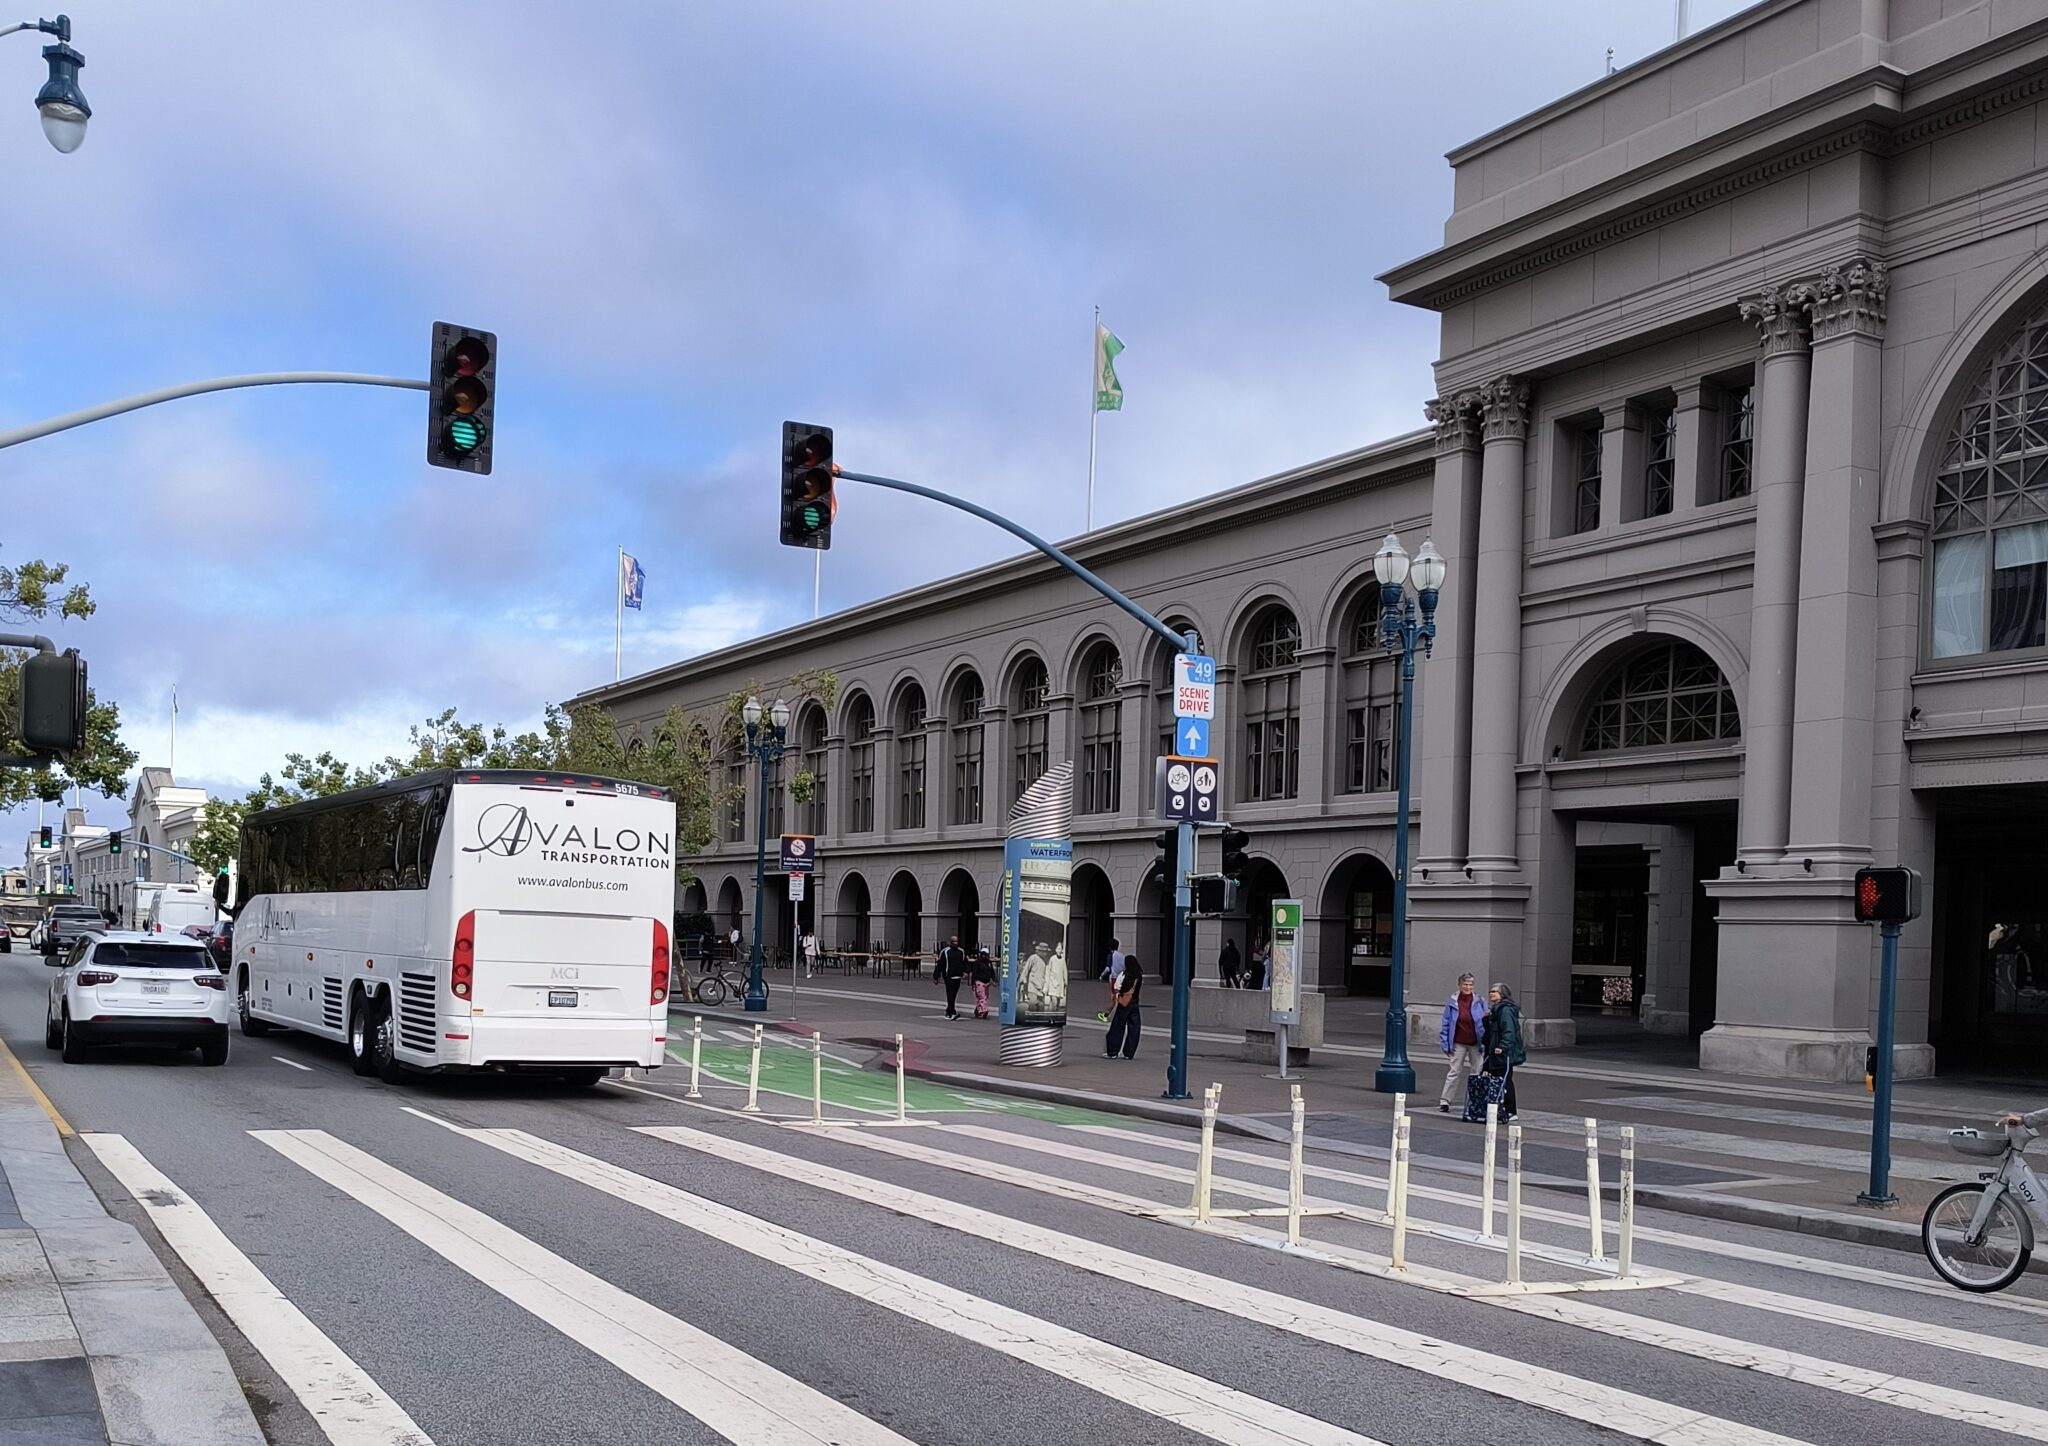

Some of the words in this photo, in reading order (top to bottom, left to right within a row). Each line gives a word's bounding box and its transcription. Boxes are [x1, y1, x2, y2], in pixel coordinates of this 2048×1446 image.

[1195, 663, 1212, 677] 49
[1179, 687, 1210, 699] SCENIC
[1179, 700, 1209, 712] DRIVE
[615, 783, 639, 795] 5675
[462, 804, 669, 857] AVALON
[541, 850, 670, 869] TRANSPORTATION
[517, 876, 629, 892] www.avalonbus.com
[1004, 868, 1013, 908] HERE
[260, 897, 296, 941] AVALON
[1002, 914, 1010, 979] HISTORY
[551, 967, 579, 979] MCI
[2019, 1181, 2036, 1203] bay
